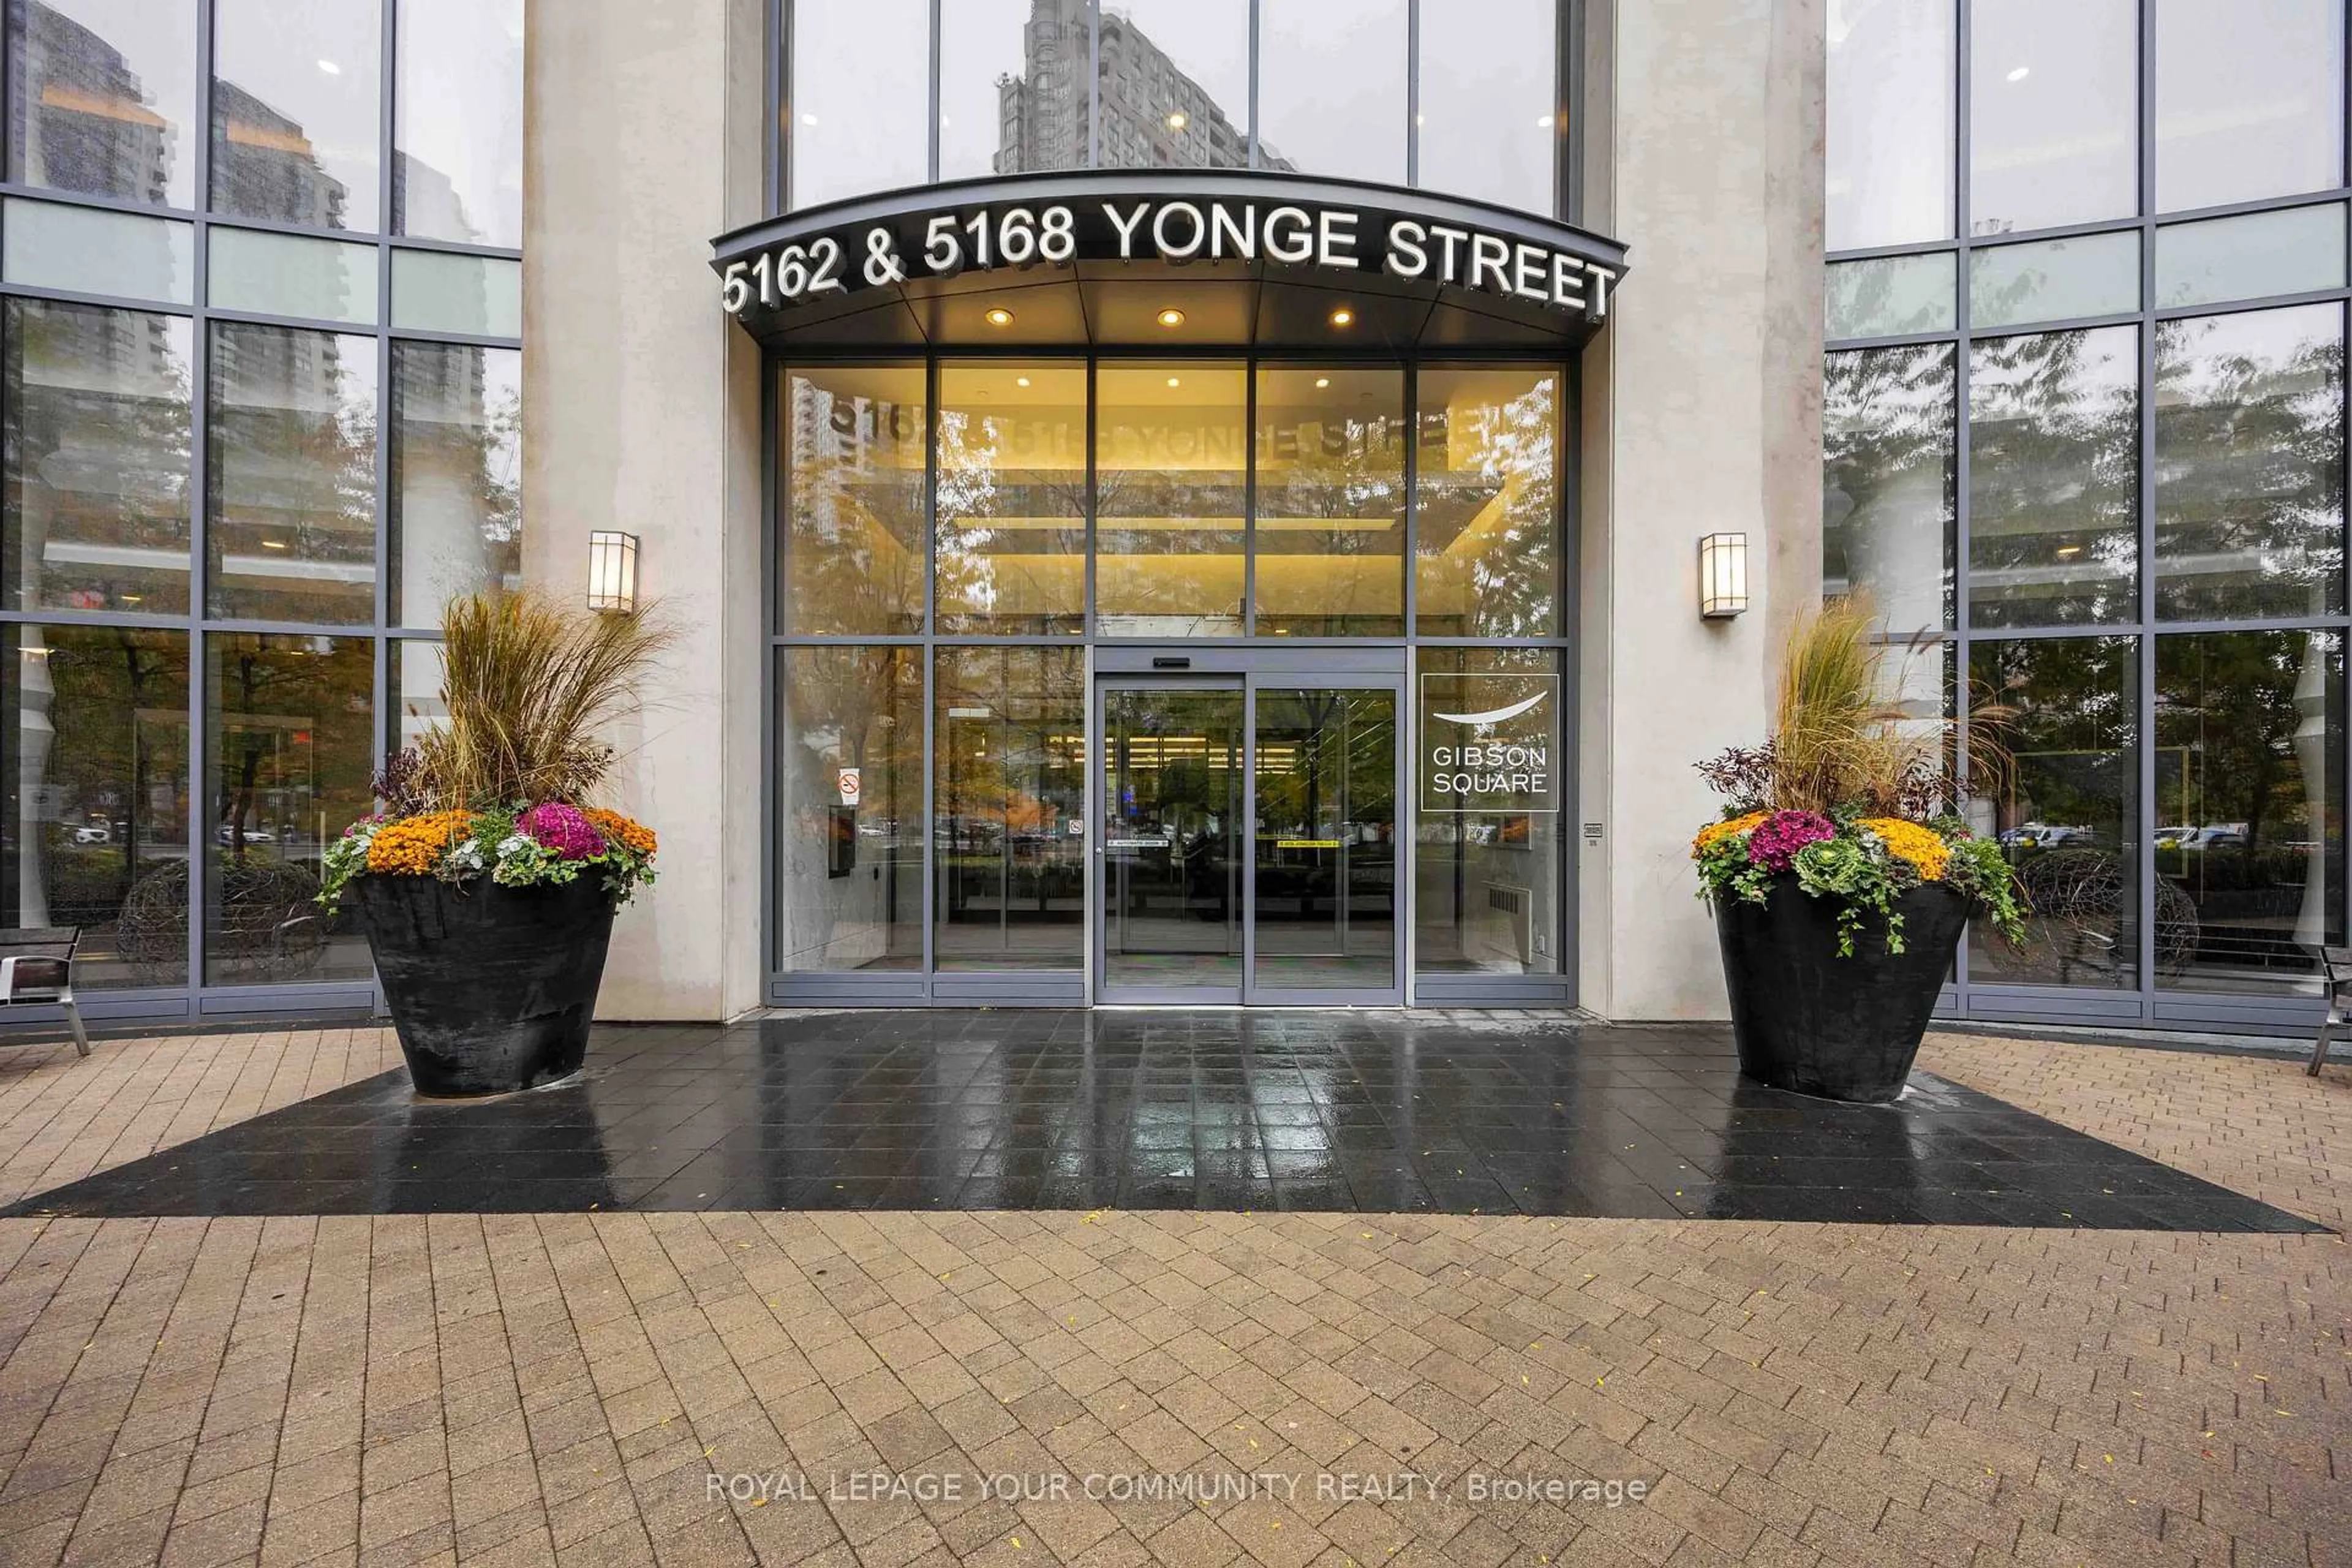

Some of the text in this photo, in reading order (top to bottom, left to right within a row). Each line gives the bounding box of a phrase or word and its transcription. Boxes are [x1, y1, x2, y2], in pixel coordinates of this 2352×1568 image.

[722, 202, 1616, 317] 5162 & 5168 YONGE STREET
[1433, 747, 1546, 766] GIBSON
[1433, 773, 1547, 794] SQUARE
